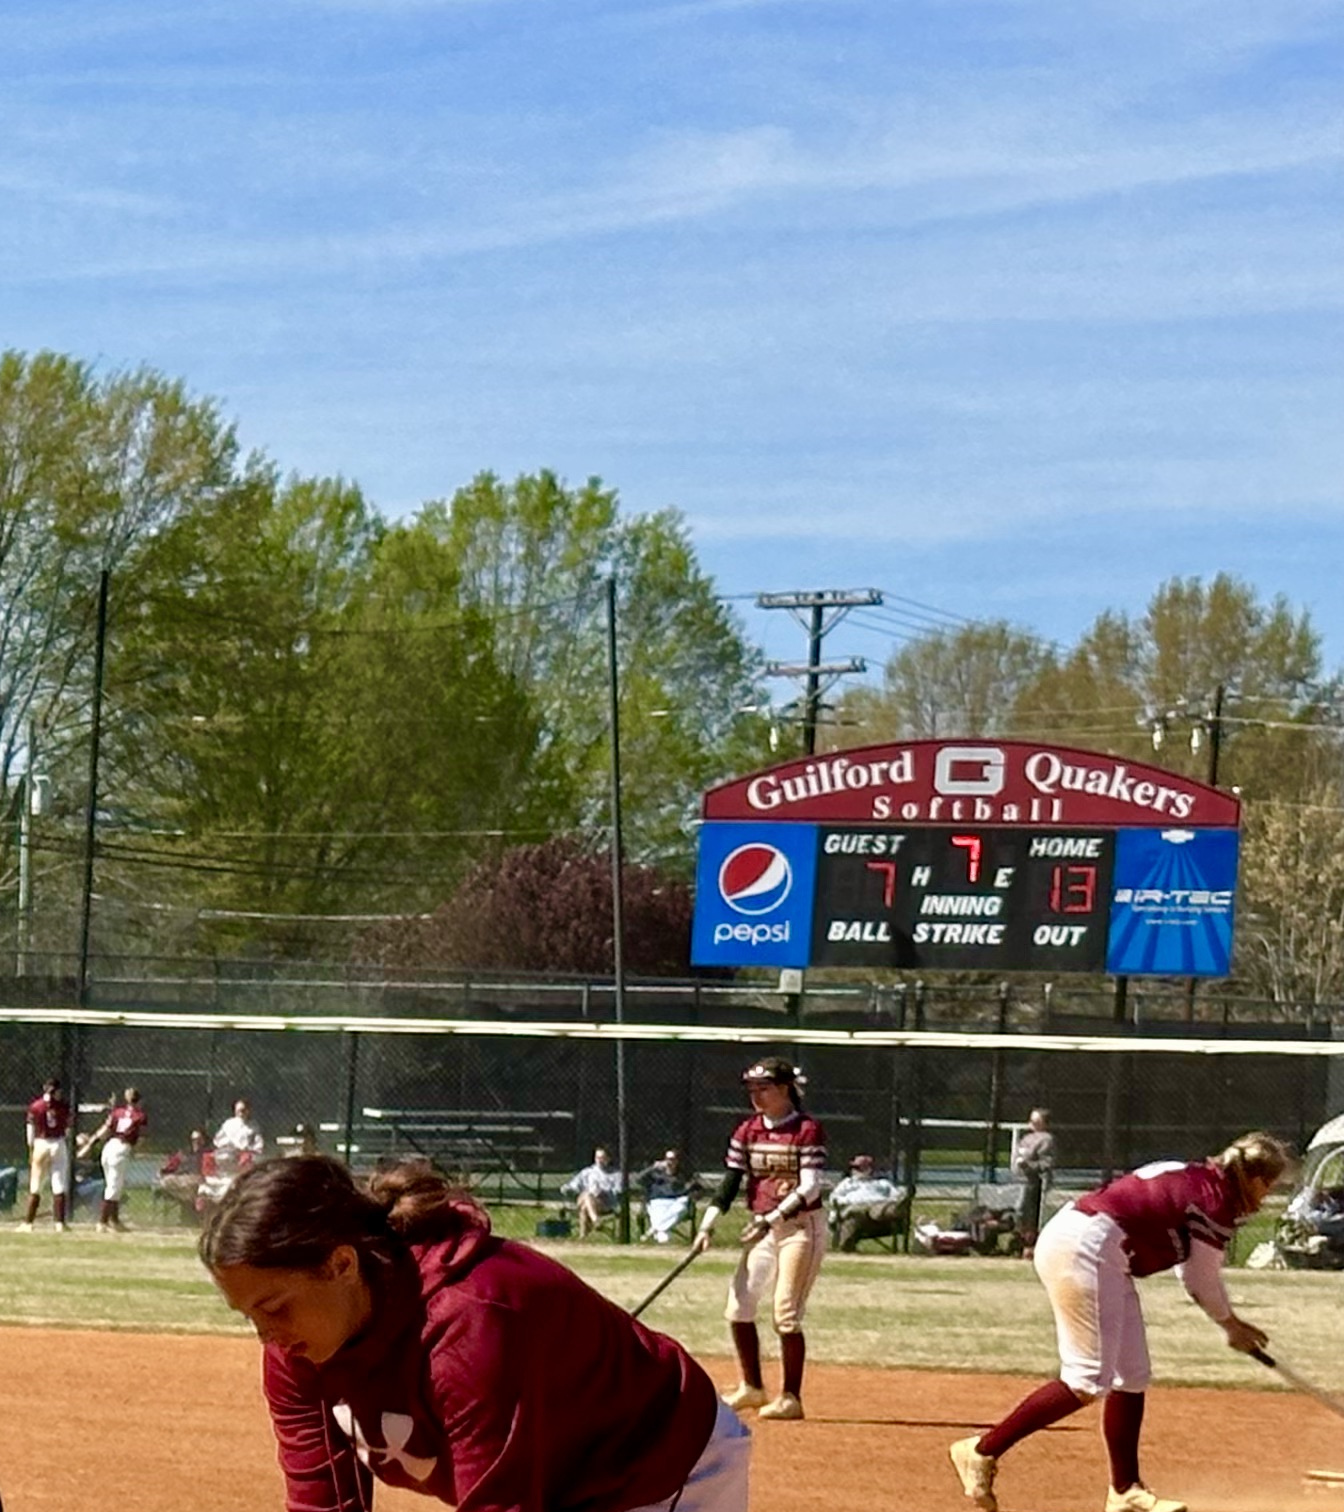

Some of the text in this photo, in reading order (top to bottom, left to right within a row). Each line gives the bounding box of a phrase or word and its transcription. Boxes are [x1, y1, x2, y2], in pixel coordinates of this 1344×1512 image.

[747, 750, 916, 810] Guilford
[1025, 751, 1196, 818] Quakers
[872, 795, 1062, 821] Softball
[823, 833, 906, 855] GUEST
[1028, 836, 1104, 858] HOME
[951, 835, 982, 883] 7
[865, 860, 897, 908] 7
[911, 865, 932, 887] H
[993, 867, 1016, 888] E
[1049, 865, 1097, 913] 13
[920, 894, 1003, 916] INNING
[714, 920, 791, 946] pepsi
[827, 920, 892, 943] BALL
[912, 922, 1008, 945] STRIKE
[1032, 924, 1088, 947] OUT
